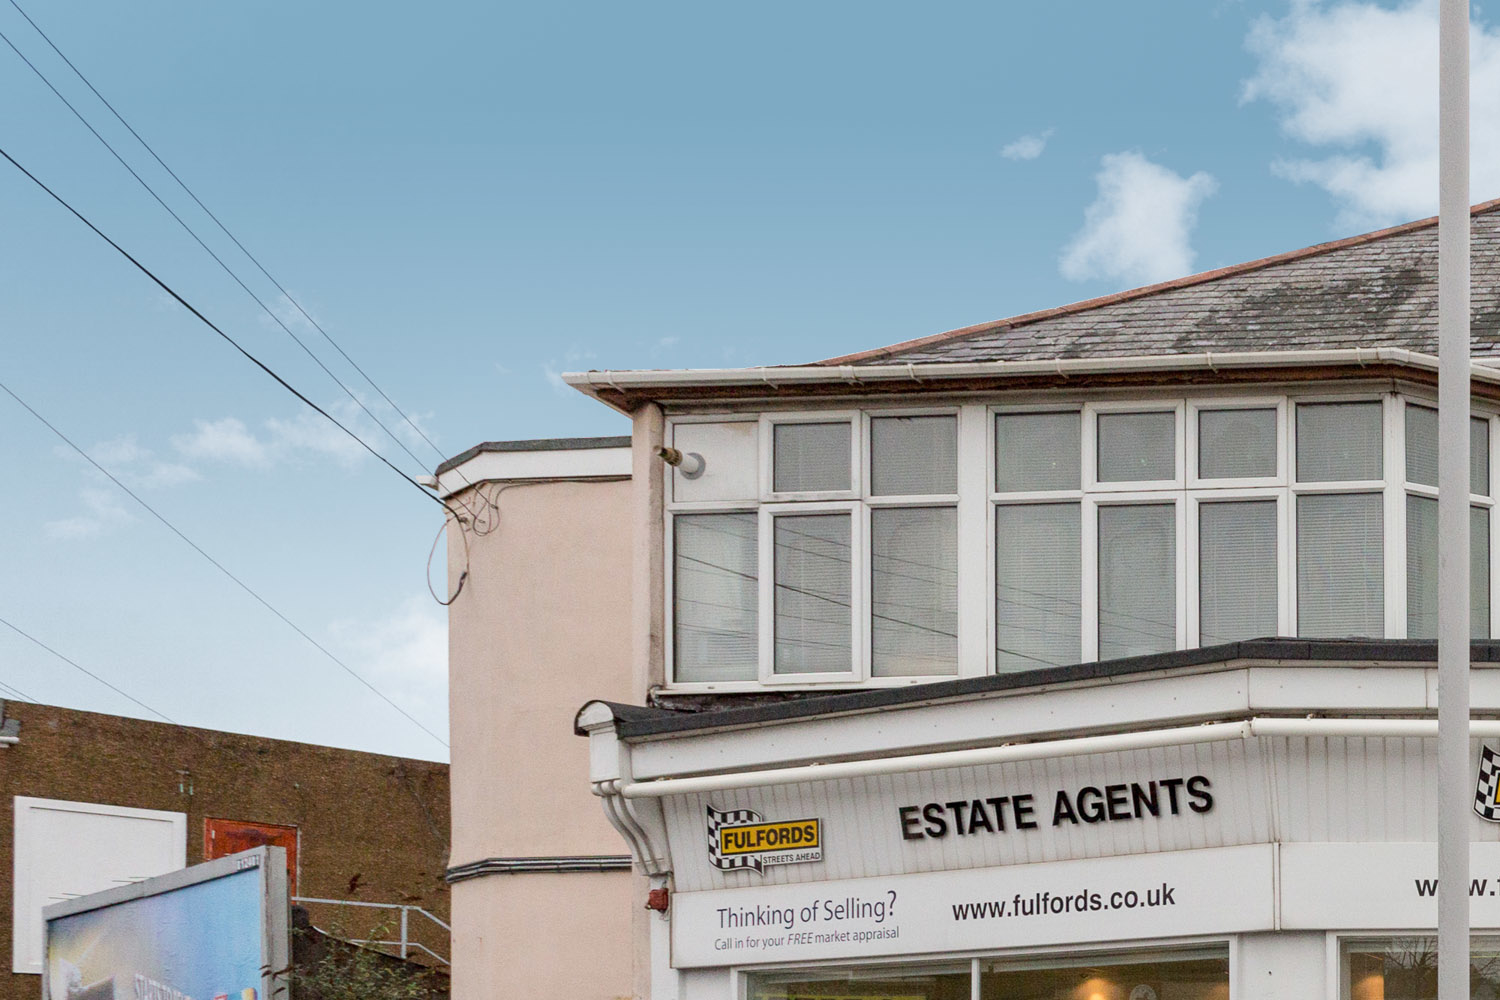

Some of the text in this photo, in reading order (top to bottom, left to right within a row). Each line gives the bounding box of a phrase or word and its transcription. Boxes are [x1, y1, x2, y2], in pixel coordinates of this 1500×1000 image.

[899, 776, 1214, 841] ESTATE AGENTS
[723, 825, 816, 850] FULFORDS
[763, 852, 821, 864] STREETS AHEAD
[717, 890, 897, 930] Thinking of Selling?
[952, 883, 1176, 921] www.fulfords.co.uk
[714, 926, 900, 951] Call in for your FREE market appraisal
